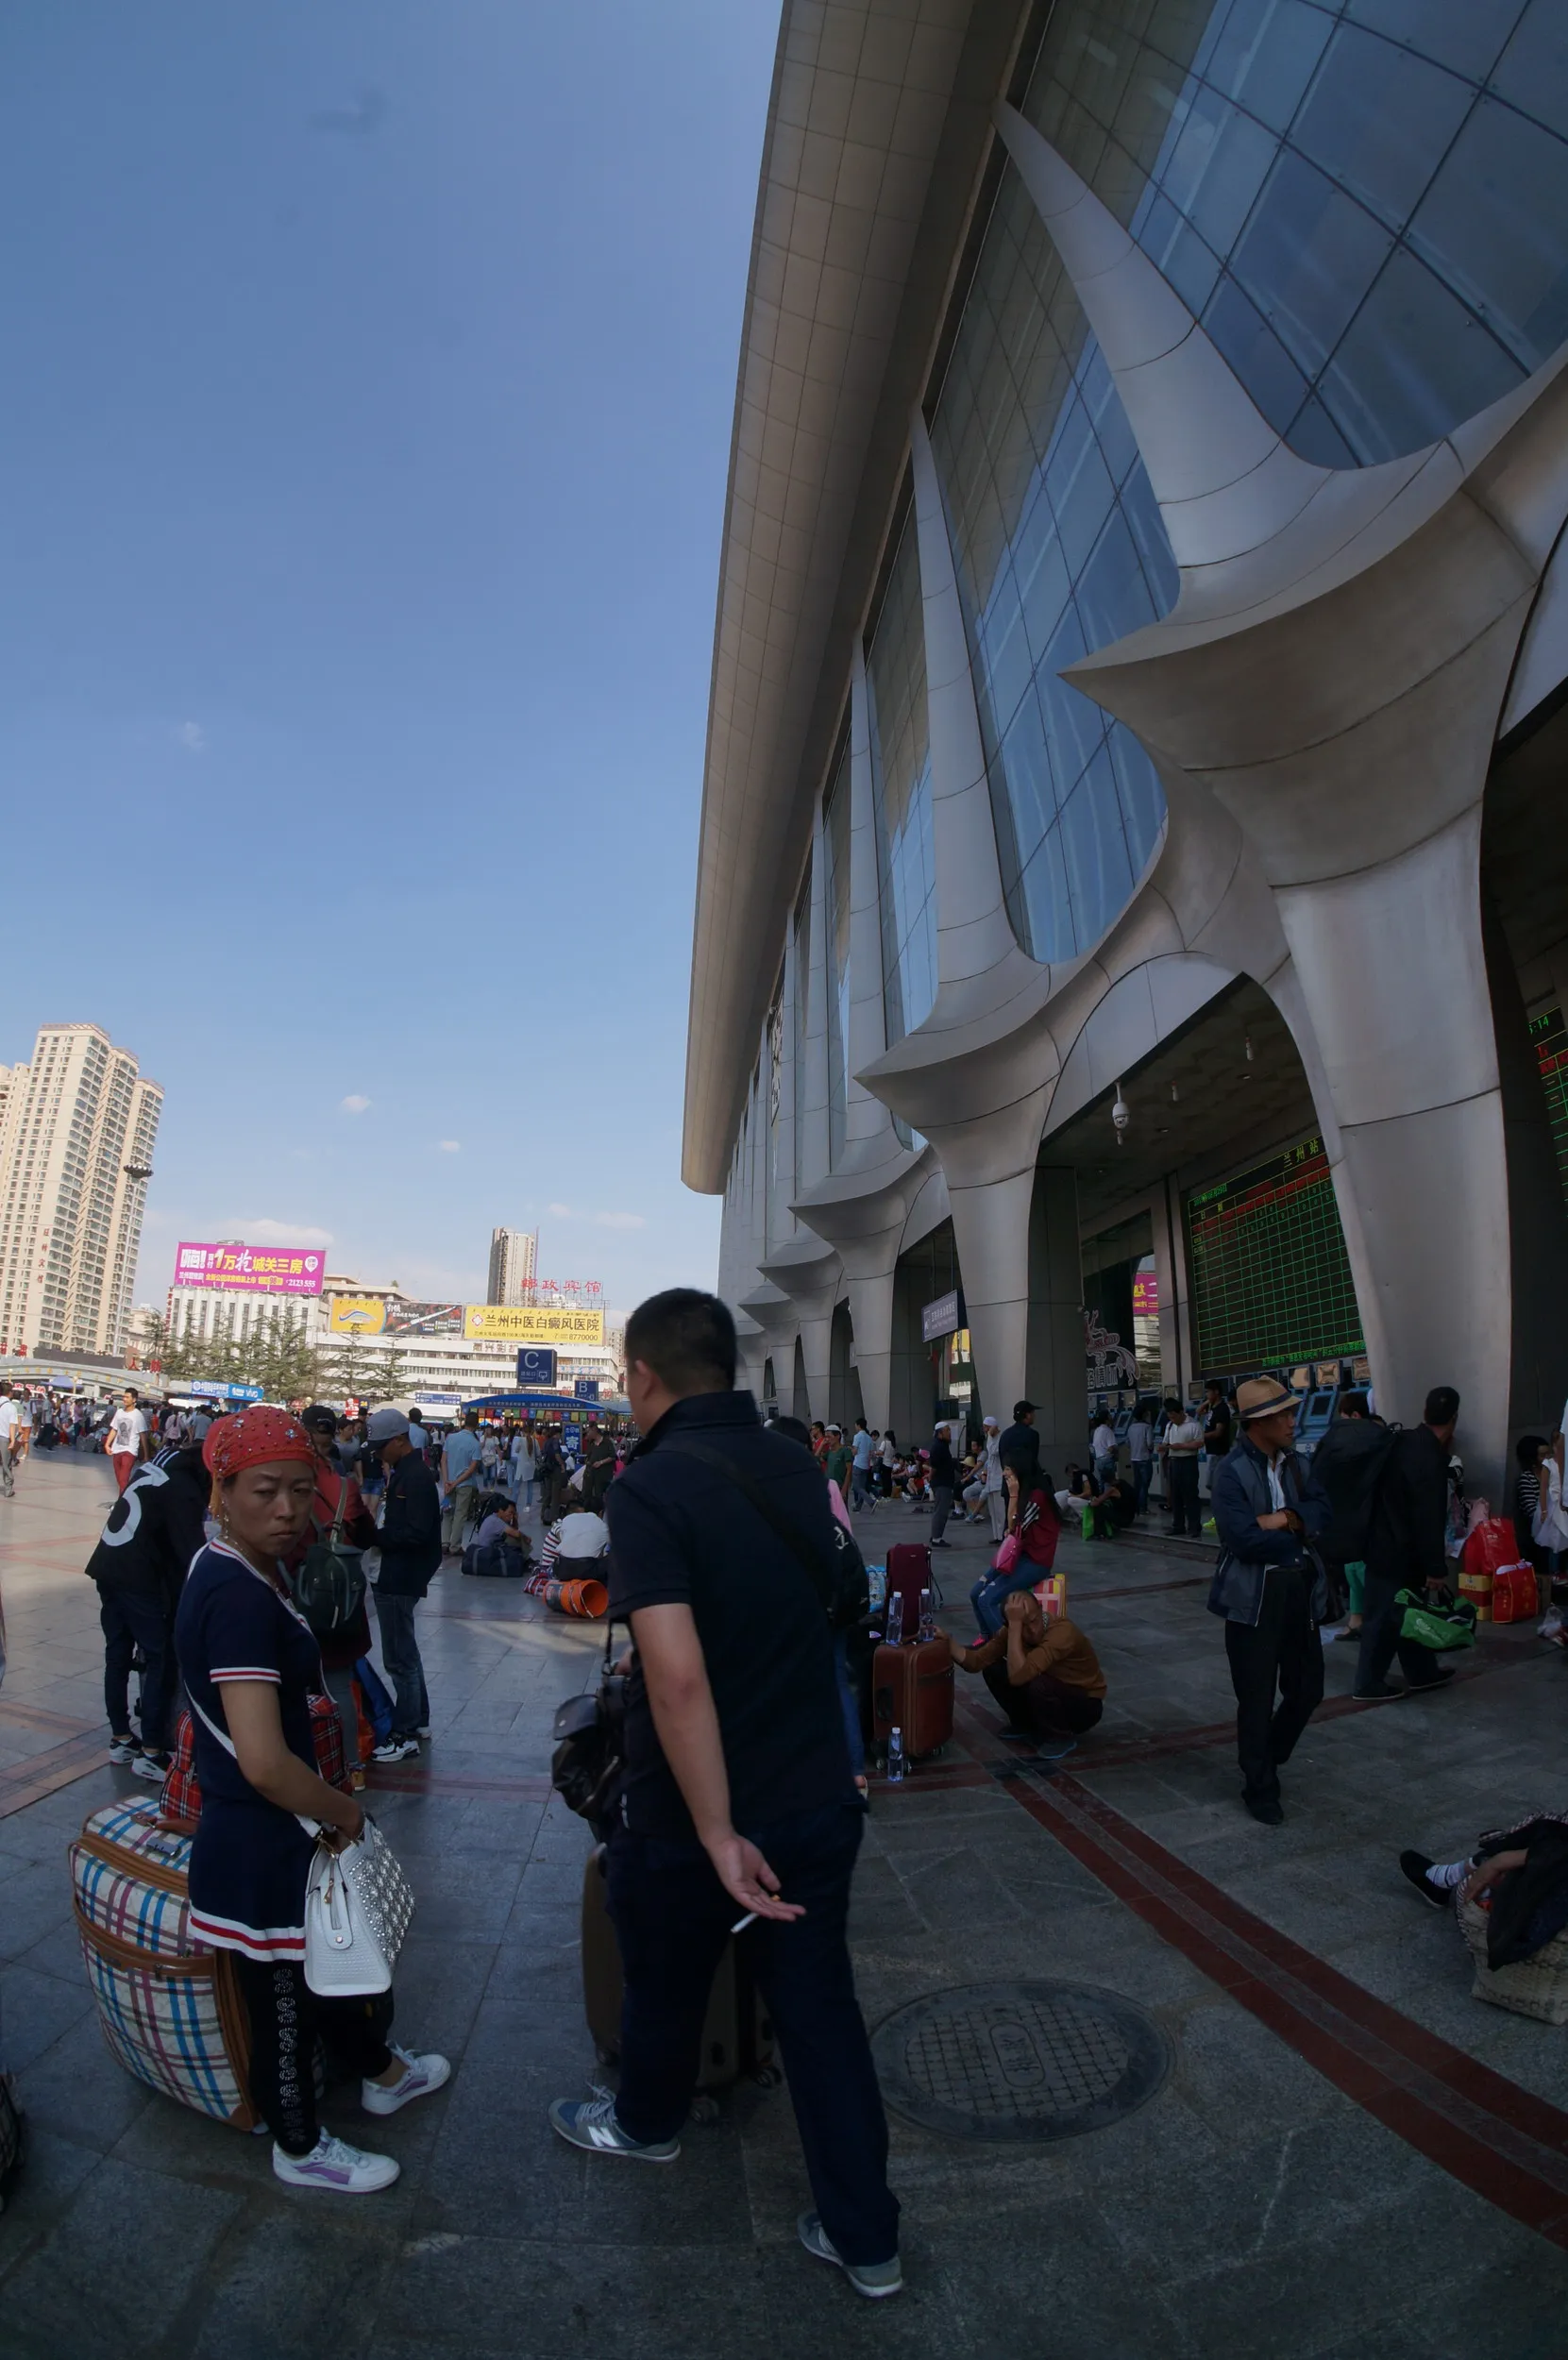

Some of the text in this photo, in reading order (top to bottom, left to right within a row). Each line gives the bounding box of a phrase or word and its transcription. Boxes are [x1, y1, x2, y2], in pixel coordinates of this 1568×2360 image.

[1284, 1140, 1319, 1169] 兰州站
[521, 1278, 601, 1293] 邮政宾馆
[484, 1314, 599, 1332] 兰州中医白癜风医院
[569, 1333, 599, 1341] 8770000
[525, 1351, 540, 1369] C
[245, 1389, 259, 1398] vivo
[579, 1382, 588, 1392] B
